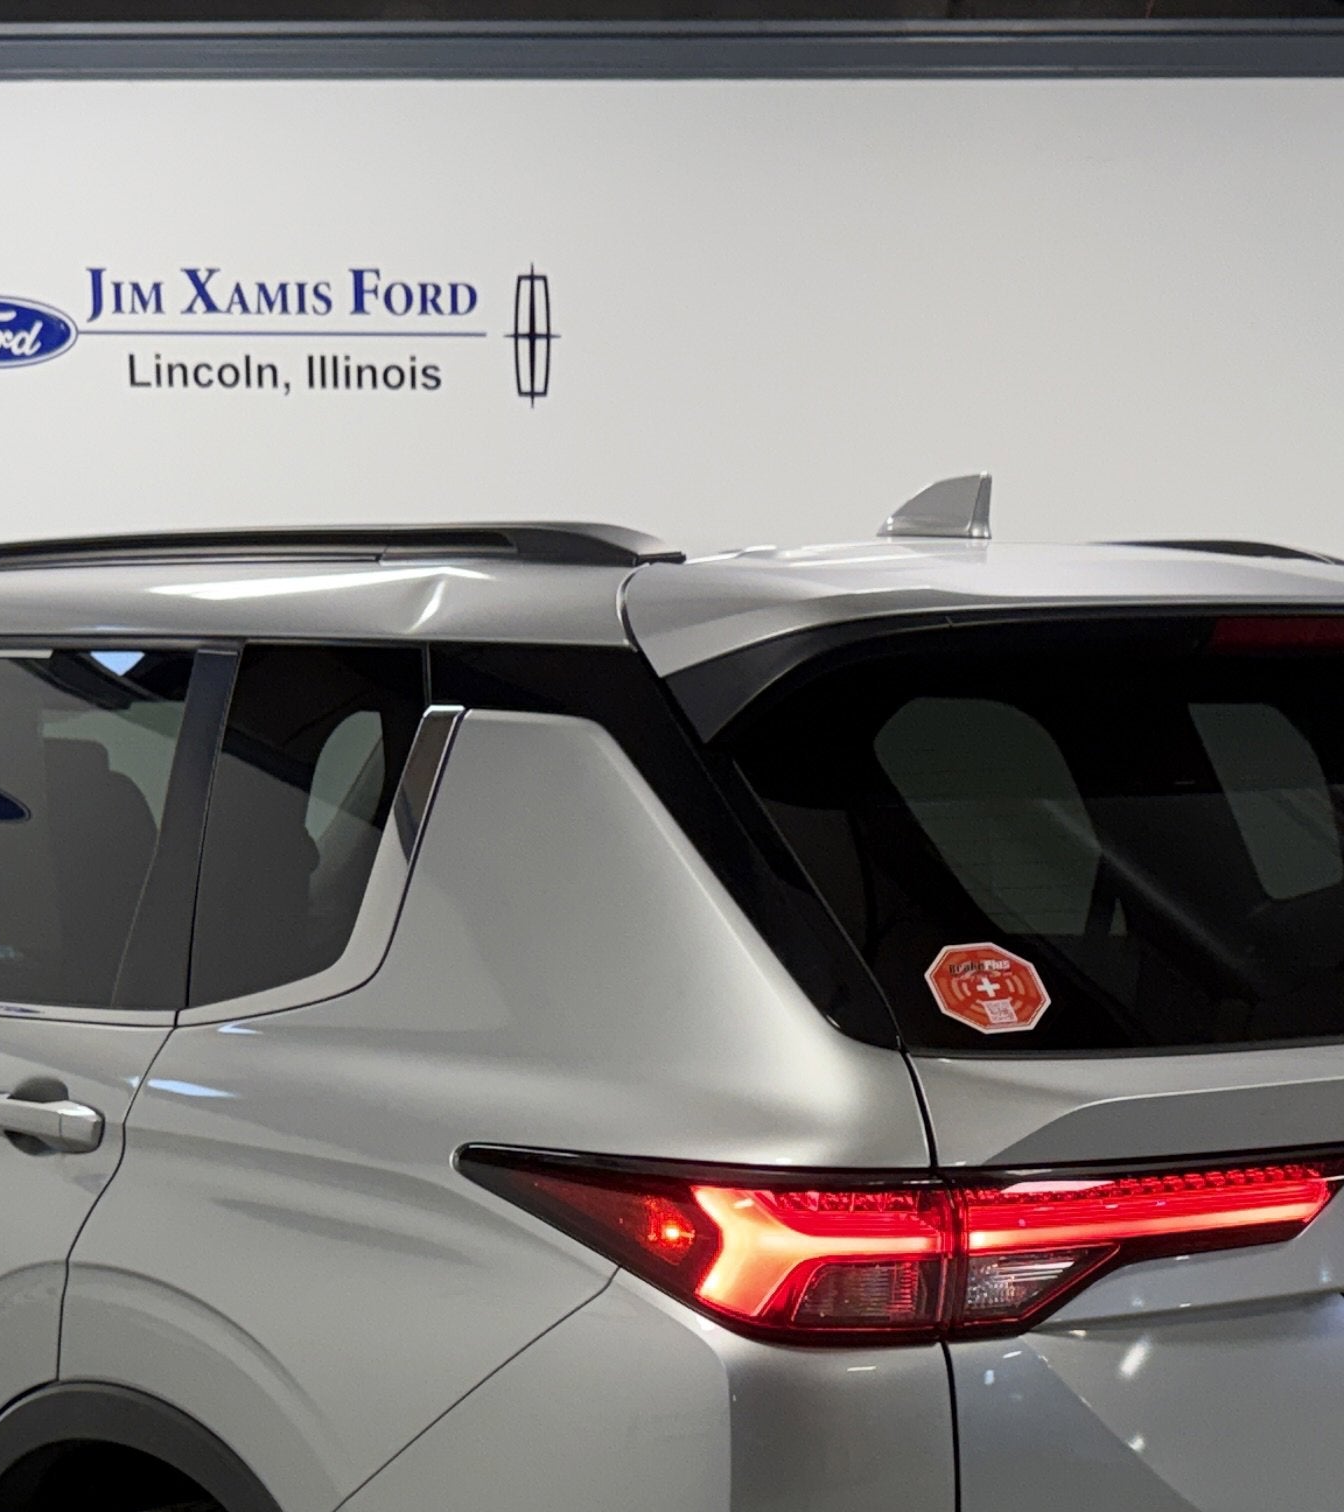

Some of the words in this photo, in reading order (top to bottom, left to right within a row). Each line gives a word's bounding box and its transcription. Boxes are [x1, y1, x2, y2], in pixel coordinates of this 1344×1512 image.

[85, 268, 165, 322] JIM
[179, 268, 333, 315] XAMIS
[348, 268, 478, 316] FORD
[127, 353, 292, 396] Lincoln,
[307, 355, 442, 390] Illinois
